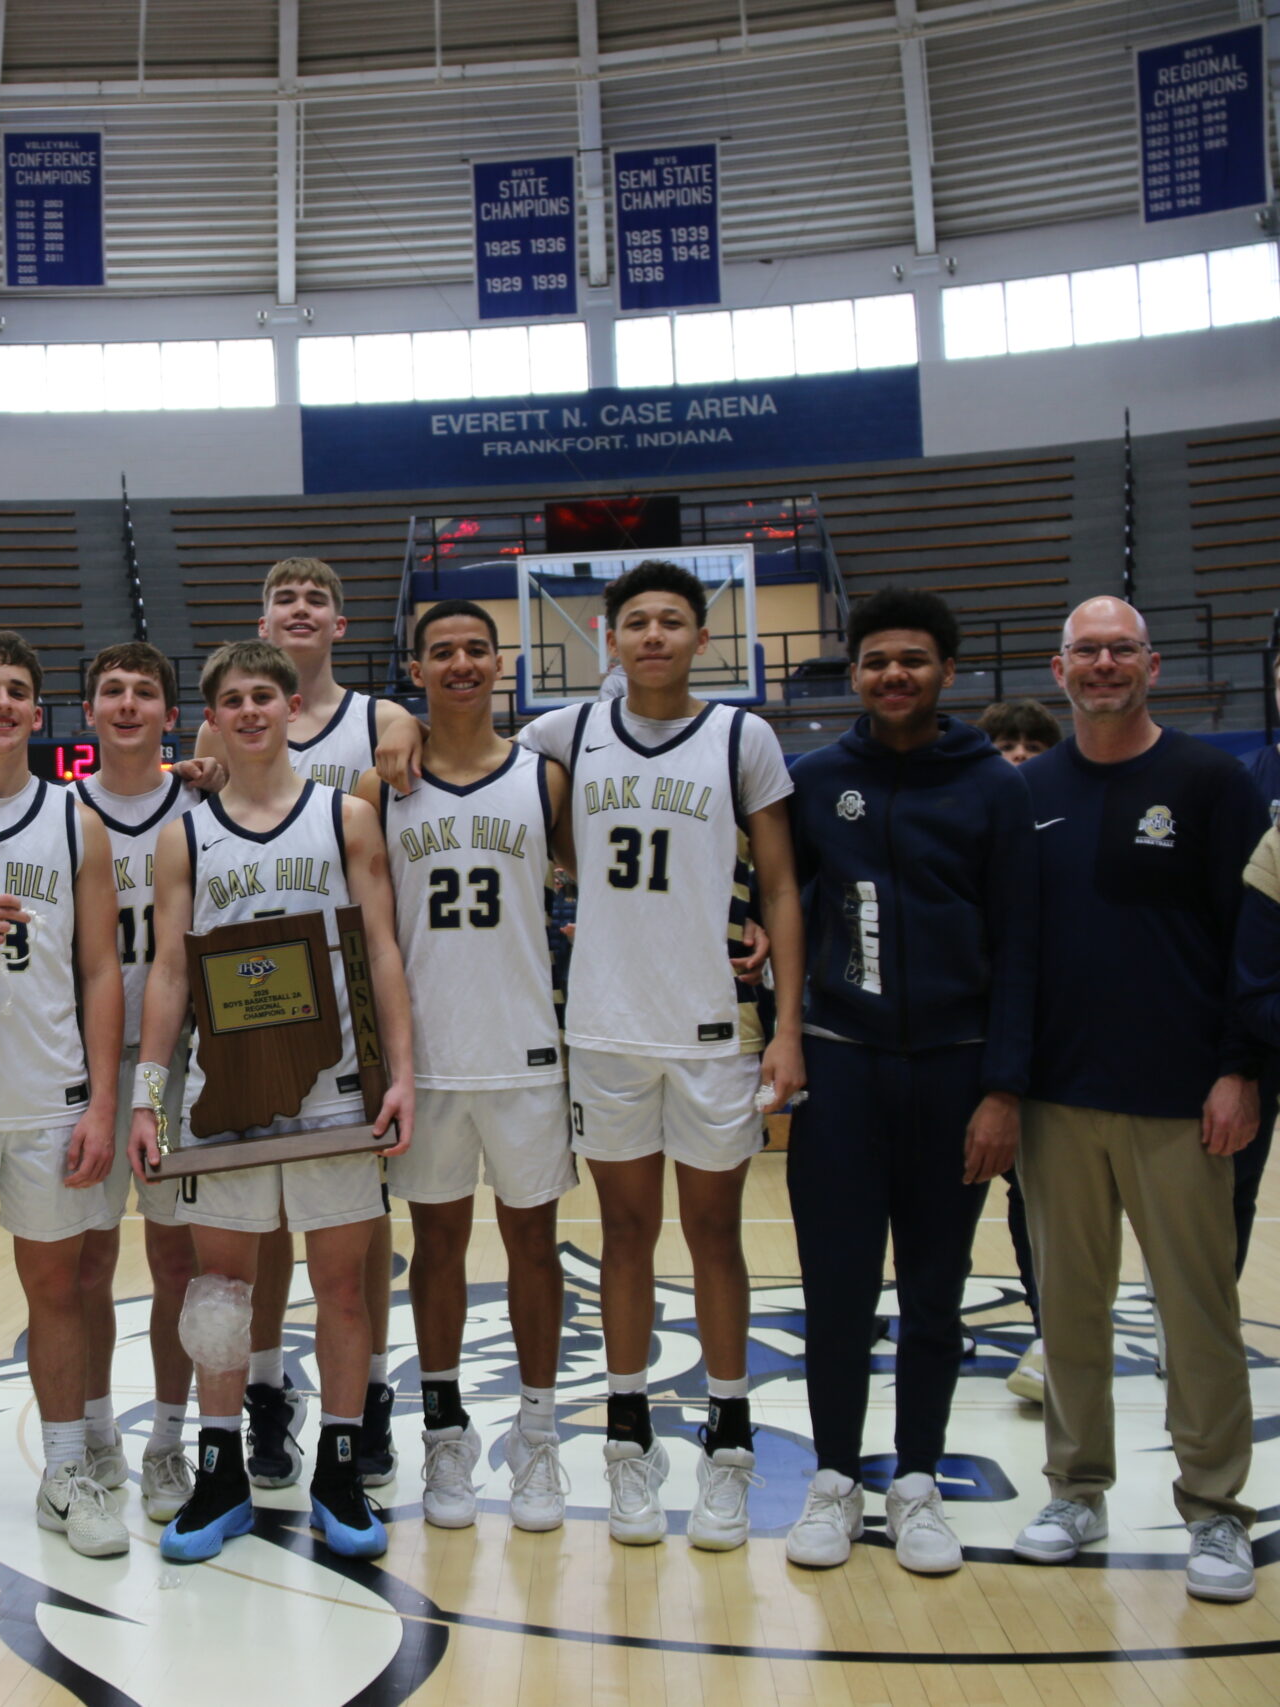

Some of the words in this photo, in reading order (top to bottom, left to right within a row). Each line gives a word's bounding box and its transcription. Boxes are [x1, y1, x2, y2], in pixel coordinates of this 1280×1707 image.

[1184, 45, 1213, 59] BOYS
[1158, 53, 1243, 86] REGIONAL
[1154, 72, 1248, 107] CHAMPIONS
[9, 152, 98, 168] CONFERENCE
[653, 156, 677, 166] BOYS
[16, 170, 92, 186] CHAMPIONS
[511, 168, 535, 178] BOYS
[619, 169, 657, 190] SEMI
[663, 164, 713, 187] STATE
[499, 177, 549, 199] STATE
[621, 186, 713, 210] CHAMPIONS
[480, 197, 570, 221] CHAMPIONS
[485, 240, 521, 257] 1925
[531, 237, 567, 254] 1936
[625, 229, 663, 247] 1925
[671, 225, 709, 243] 1939
[626, 247, 664, 265] 1929
[672, 244, 711, 262] 1942
[486, 277, 522, 293] 1929
[532, 273, 568, 290] 1939
[628, 266, 665, 283] 1936
[431, 409, 549, 436] EVERETT
[562, 408, 587, 429] N.
[601, 402, 673, 427] CASE
[686, 394, 778, 421] ARENA
[636, 427, 733, 448] INDIANA
[584, 775, 641, 816] OAK
[651, 776, 712, 822] HILL
[400, 815, 461, 862] OAK
[471, 815, 527, 859] HILL
[607, 825, 670, 893] 31
[5, 861, 59, 905] HILL
[207, 861, 266, 910] OAK
[276, 857, 330, 896] HILL
[428, 866, 502, 931] 23
[117, 903, 156, 965] 11
[856, 880, 882, 995] GOLDEN
[236, 958, 278, 976] IHSAA
[223, 1000, 243, 1009] BOYS
[244, 994, 290, 1006] BASKETBALL
[245, 1002, 282, 1012] REGIONAL
[243, 1008, 286, 1020] CHAMPIONS
